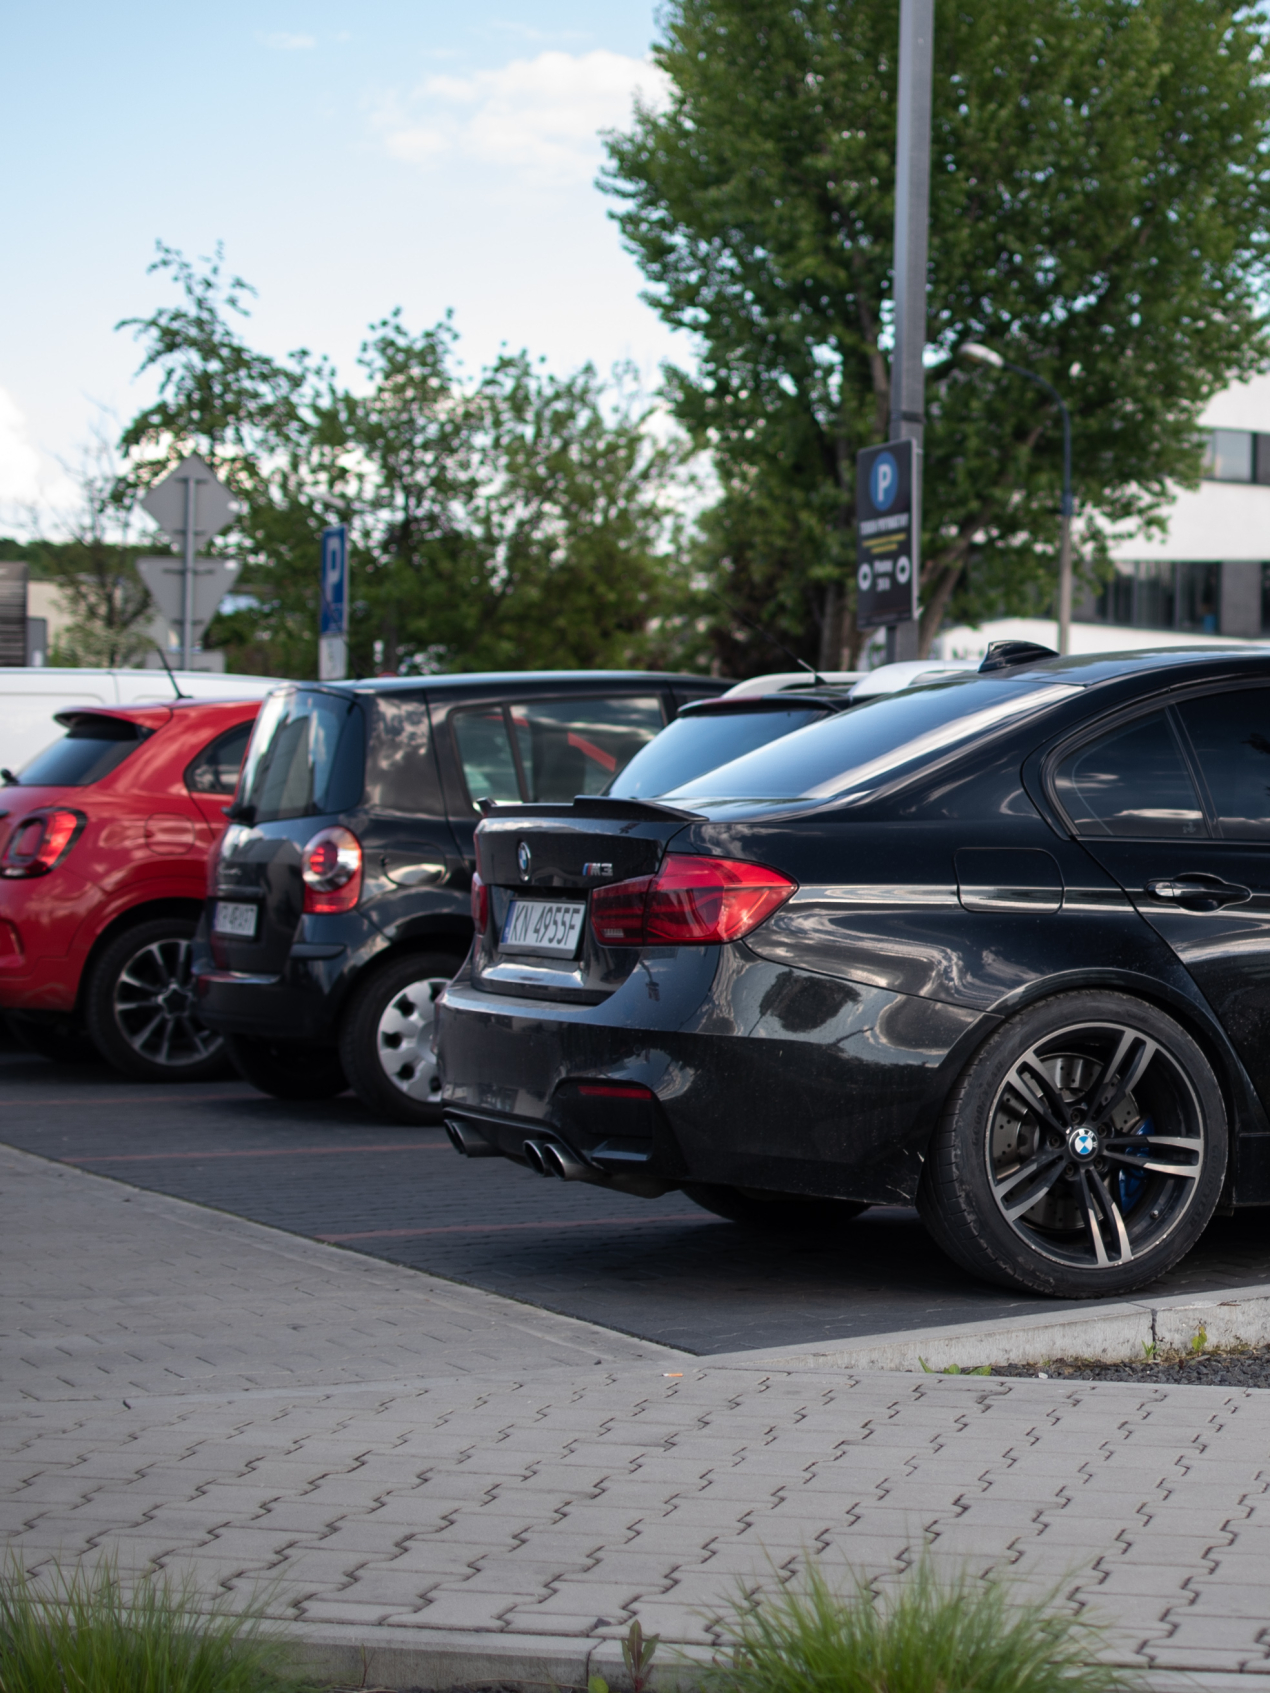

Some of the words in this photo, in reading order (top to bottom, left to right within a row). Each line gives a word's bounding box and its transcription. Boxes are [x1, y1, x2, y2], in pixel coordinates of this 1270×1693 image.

[877, 463, 893, 503] P
[325, 536, 342, 602] P
[589, 862, 613, 877] M3
[510, 904, 534, 942] KN
[533, 905, 581, 946] 4955F
[1078, 1128, 1098, 1148] BMW
